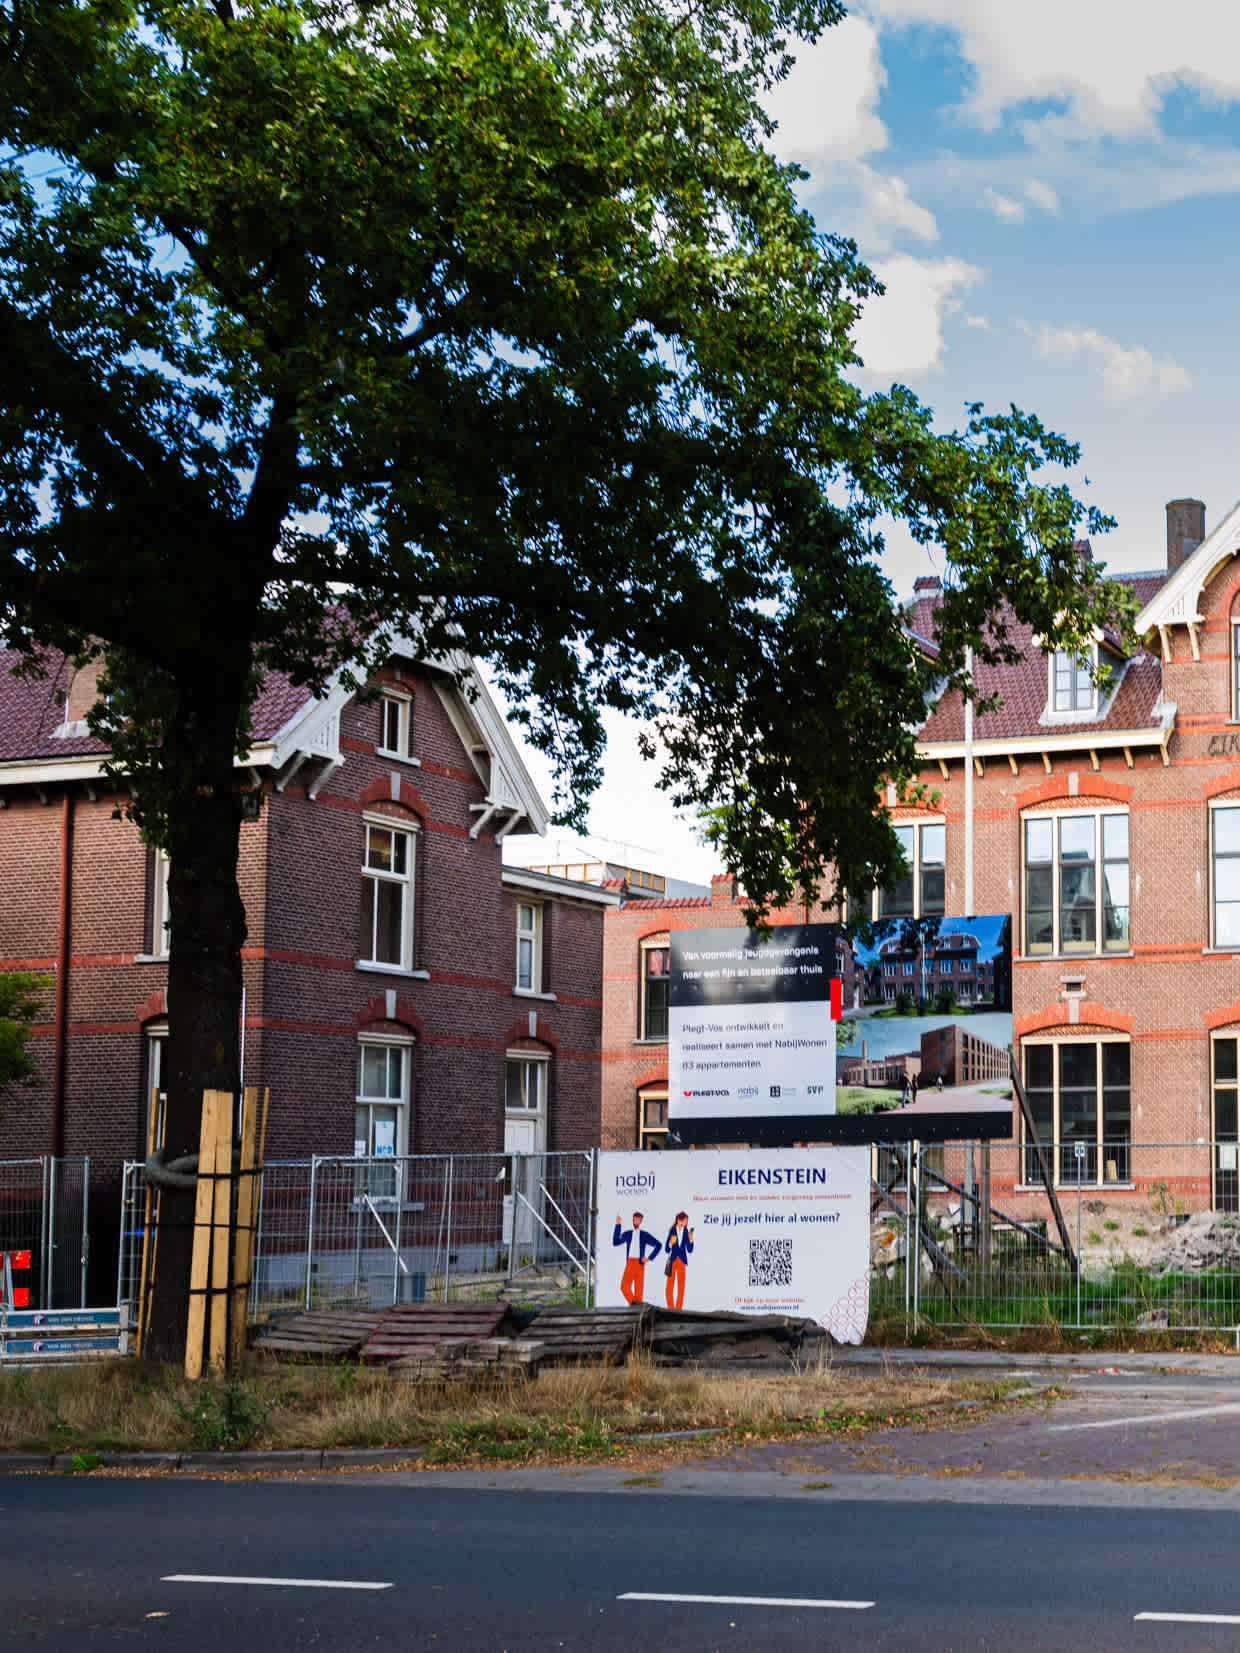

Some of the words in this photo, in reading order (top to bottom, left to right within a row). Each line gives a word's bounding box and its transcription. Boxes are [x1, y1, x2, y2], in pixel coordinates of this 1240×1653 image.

[800, 964, 823, 974] thuis
[682, 1023, 723, 1034] Plegt-Vos
[725, 1022, 770, 1032] ontwikkelt
[725, 1042, 754, 1050] samen
[756, 1040, 772, 1049] met
[775, 1039, 827, 1050] NabijWonen
[696, 1059, 761, 1072] appartementen
[616, 1170, 655, 1190] nabij
[718, 1168, 827, 1185] EIKENSTEIN
[704, 1214, 719, 1224] Zie
[721, 1213, 731, 1226] jij
[734, 1212, 762, 1226] jezelf
[765, 1212, 785, 1223] hier
[788, 1212, 797, 1223] al
[800, 1212, 841, 1223] wonen?
